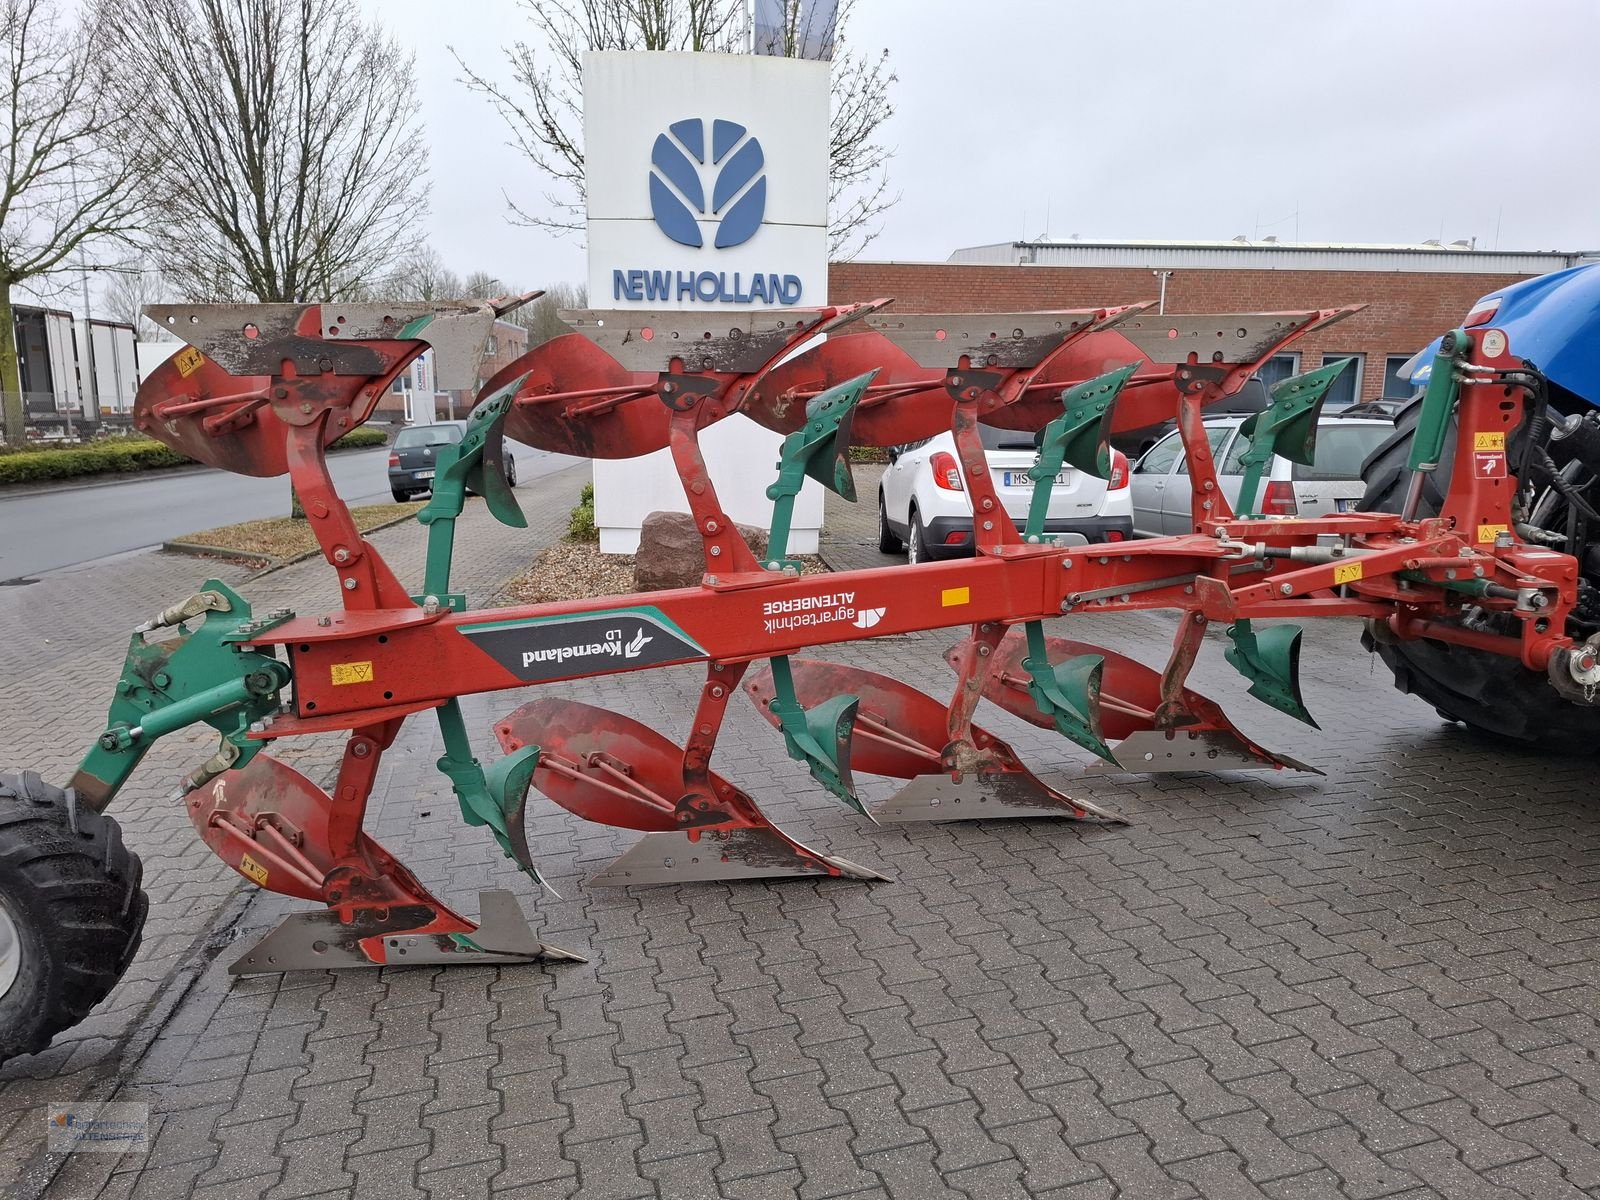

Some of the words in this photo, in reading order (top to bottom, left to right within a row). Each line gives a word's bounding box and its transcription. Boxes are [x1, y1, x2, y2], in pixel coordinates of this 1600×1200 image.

[613, 269, 672, 301] NEW
[676, 271, 803, 305] HOLLAND
[763, 591, 856, 616] ALTENBERGE
[605, 629, 622, 641] LD
[764, 608, 855, 635] agrartechnik
[522, 641, 622, 668] Kverneland
